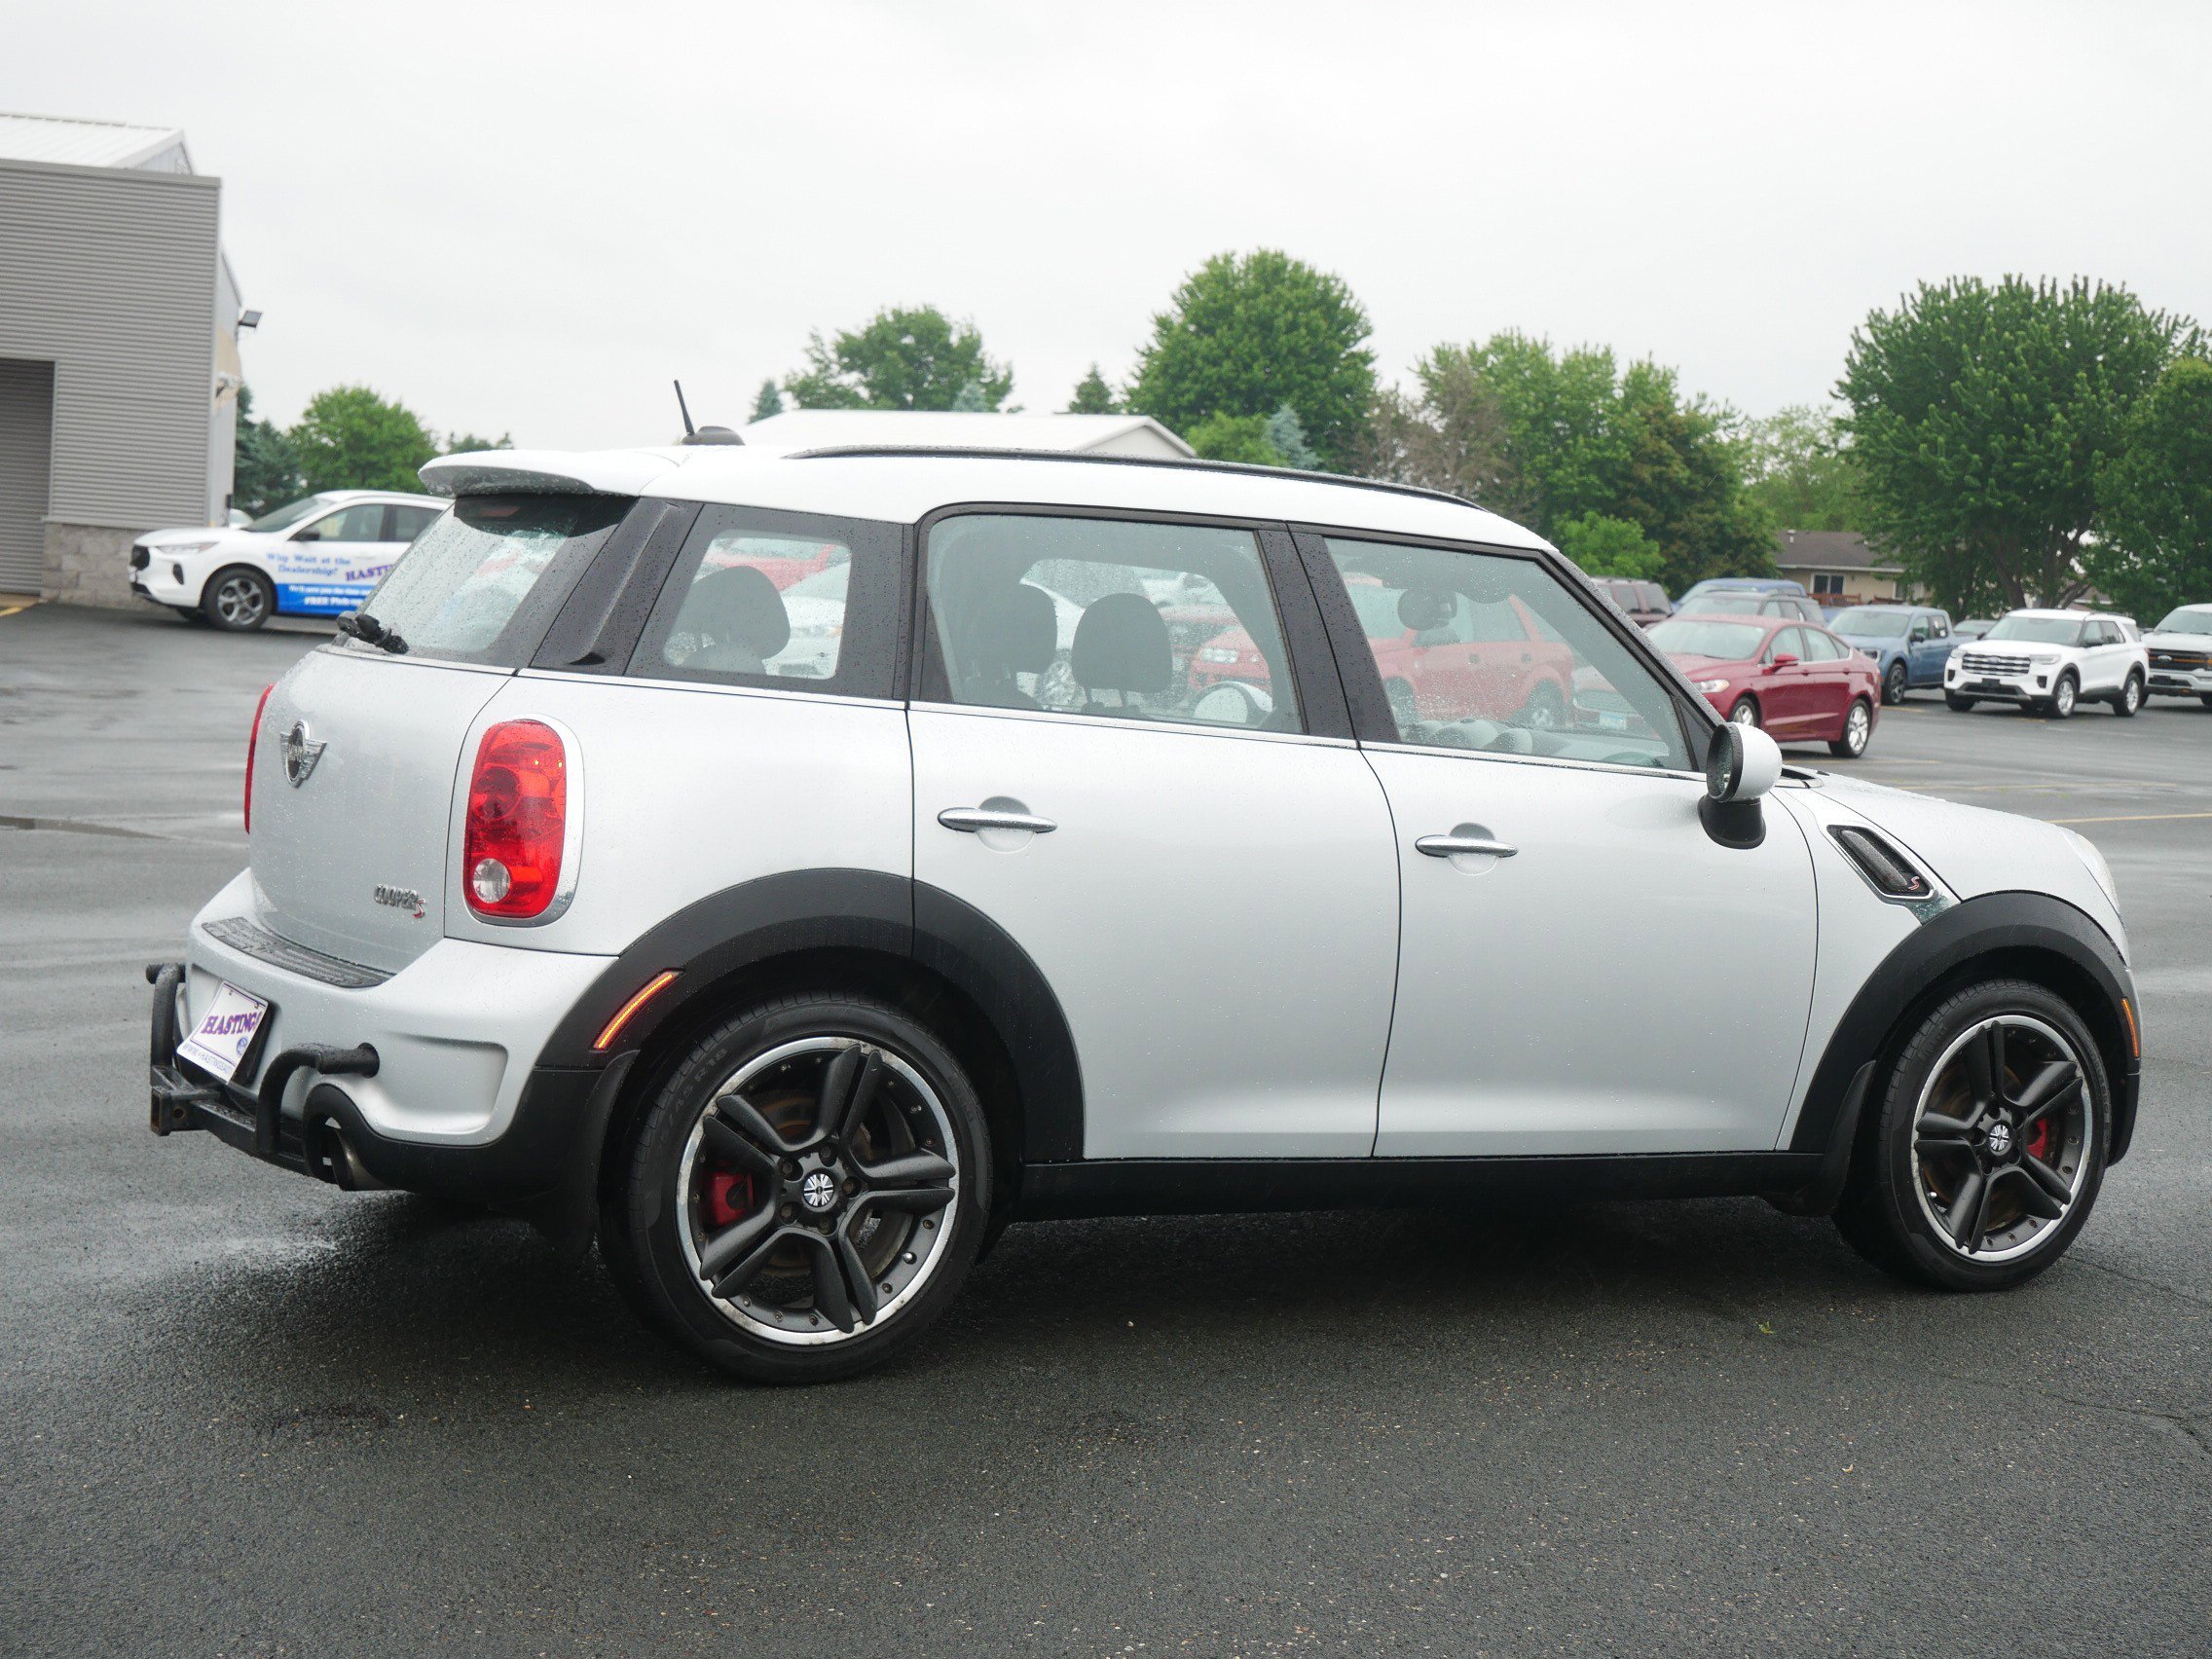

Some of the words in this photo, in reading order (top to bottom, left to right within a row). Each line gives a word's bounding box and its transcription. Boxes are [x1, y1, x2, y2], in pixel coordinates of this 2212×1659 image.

[295, 553, 316, 563] Wait
[1908, 875, 1920, 891] S
[374, 884, 419, 911] COOPER
[412, 898, 426, 919] S
